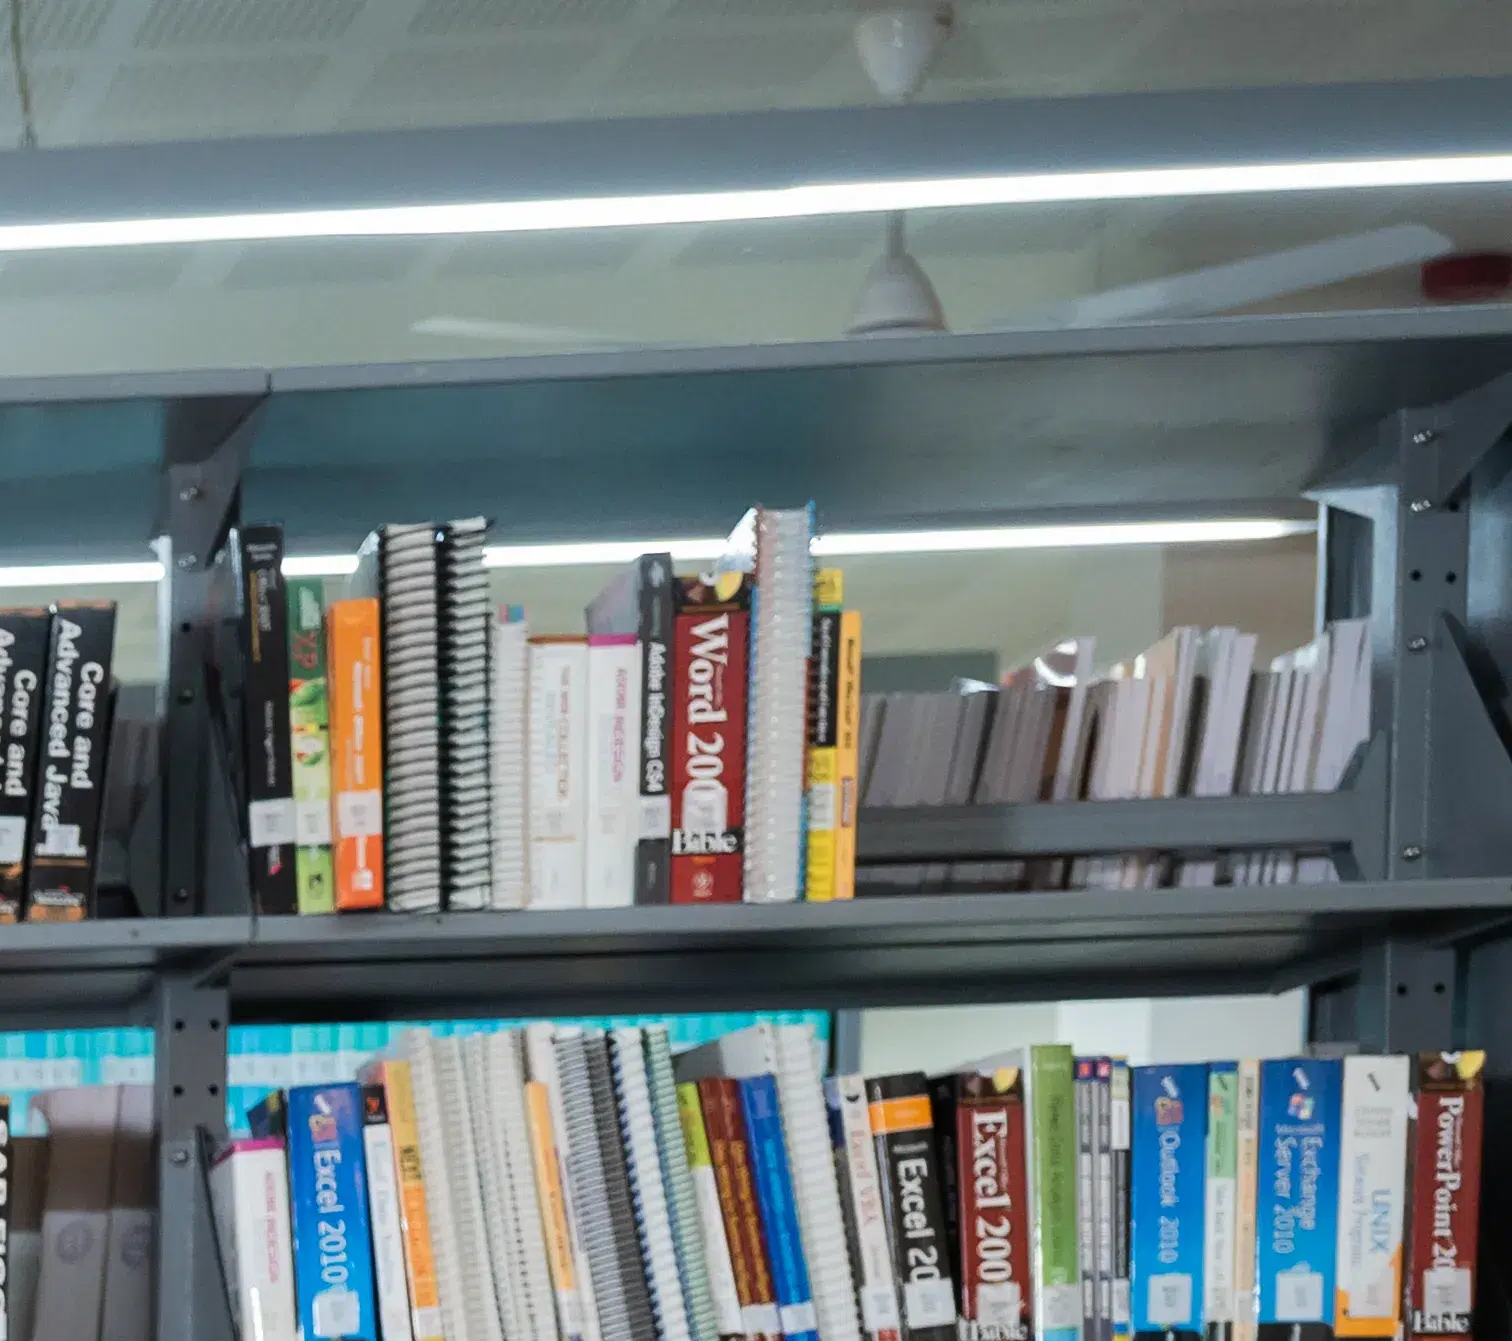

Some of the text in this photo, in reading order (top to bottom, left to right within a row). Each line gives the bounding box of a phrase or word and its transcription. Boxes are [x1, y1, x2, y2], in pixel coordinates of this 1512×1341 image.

[50, 619, 80, 757] Advanced
[70, 661, 103, 789] Core and
[687, 614, 728, 723] Word
[5, 670, 36, 796] Core and
[314, 1150, 346, 1281] Excel 2010
[903, 1159, 931, 1239] Excel
[973, 1110, 1009, 1210] Excel
[1161, 1133, 1179, 1262] Outlook 2010
[1274, 1138, 1295, 1252] Server 2010
[1300, 1138, 1323, 1228] Exchange
[1434, 1099, 1462, 1237] PowerPoint
[1372, 1189, 1390, 1252] UNIX
